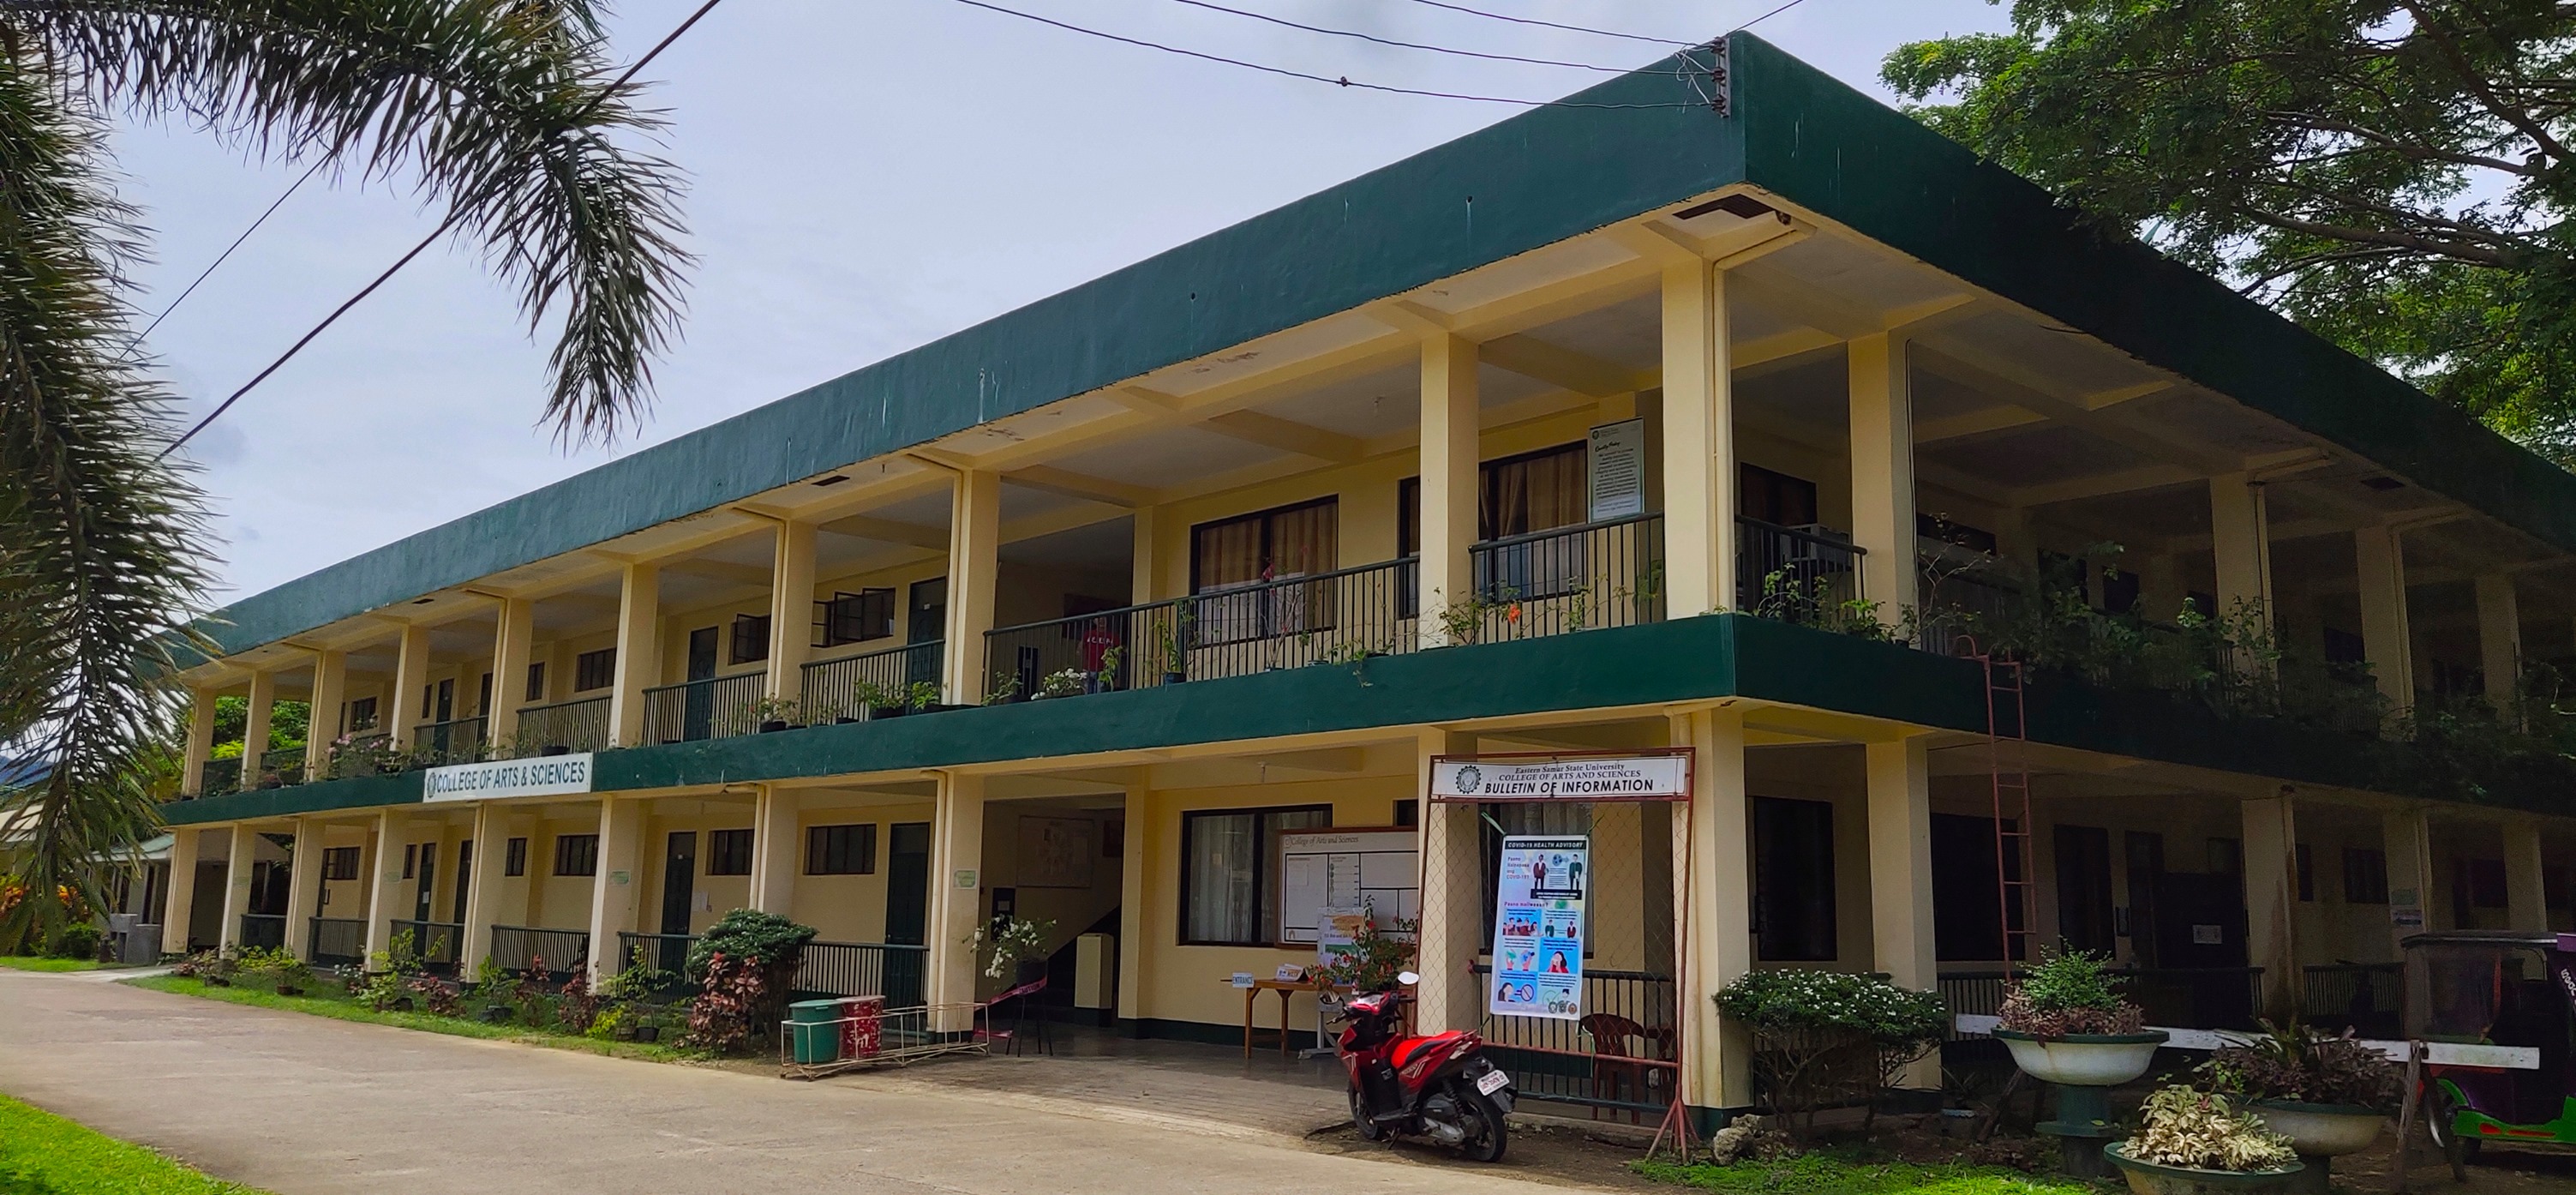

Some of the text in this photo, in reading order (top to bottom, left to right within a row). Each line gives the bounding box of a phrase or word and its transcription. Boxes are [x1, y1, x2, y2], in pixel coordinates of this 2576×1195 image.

[1585, 763, 1625, 772] University
[436, 761, 585, 793] COLLEGE OF ARTS & SCIENCES
[1499, 773, 1538, 782] COLLEGE
[1597, 770, 1641, 778] SCIENCES
[1485, 779, 1653, 794] BULLETIN OF INFORMATION
[1339, 835, 1359, 844] Sciences
[1232, 976, 1253, 985] ENTRANCE
